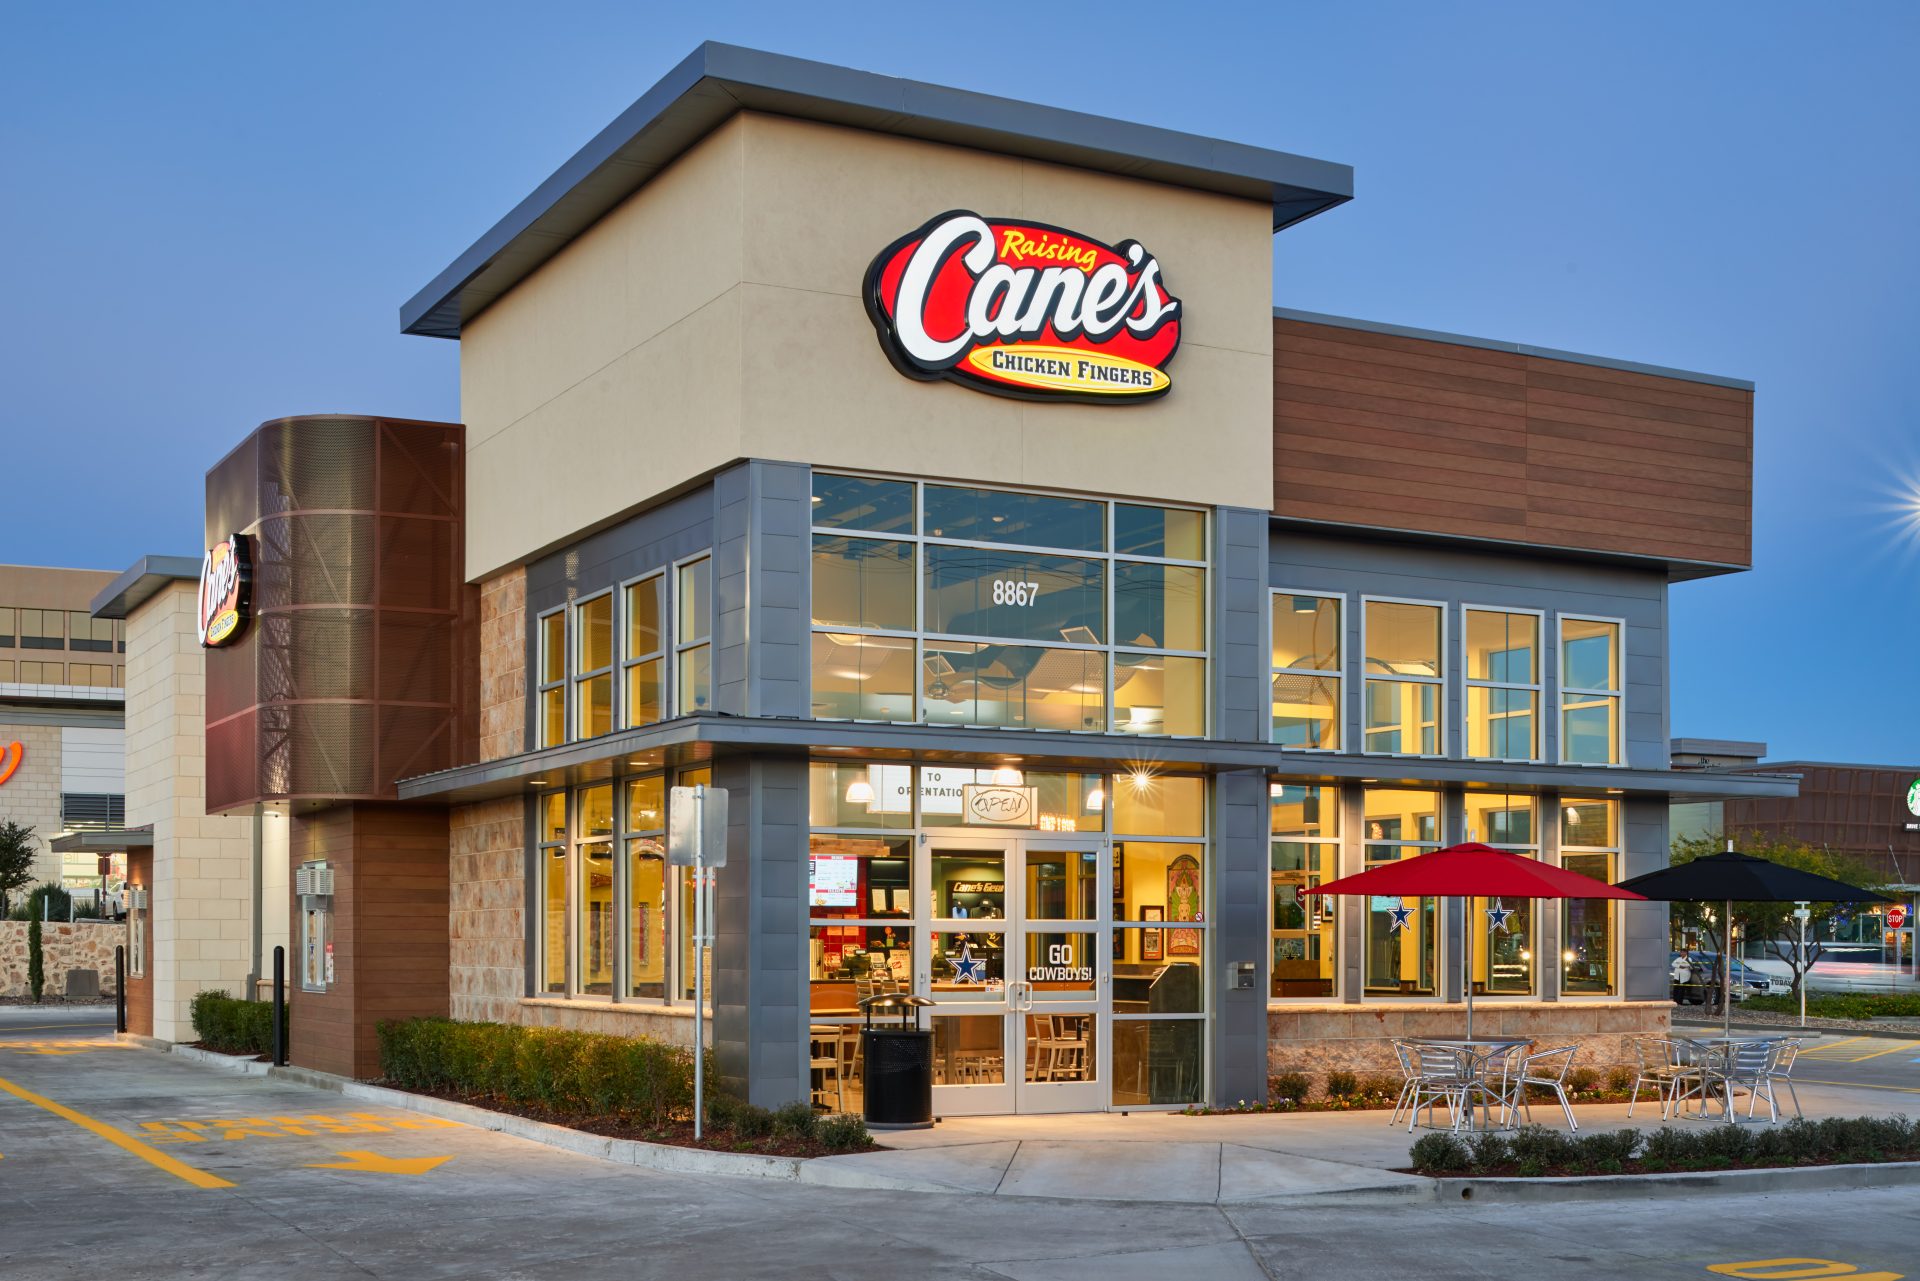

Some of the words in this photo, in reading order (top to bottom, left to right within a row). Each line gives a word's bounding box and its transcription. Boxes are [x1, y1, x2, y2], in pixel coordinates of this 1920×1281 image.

[1001, 230, 1098, 271] Raising
[896, 215, 1177, 361] Cane's
[992, 350, 1071, 377] CHICKEN
[1077, 361, 1152, 386] FINGERS
[992, 580, 1039, 607] 8867
[928, 772, 941, 781] TO
[975, 797, 1023, 813] OPEN
[953, 882, 983, 892] Cane's
[1049, 944, 1073, 965] GO
[1029, 966, 1092, 981] COWBOYS!
